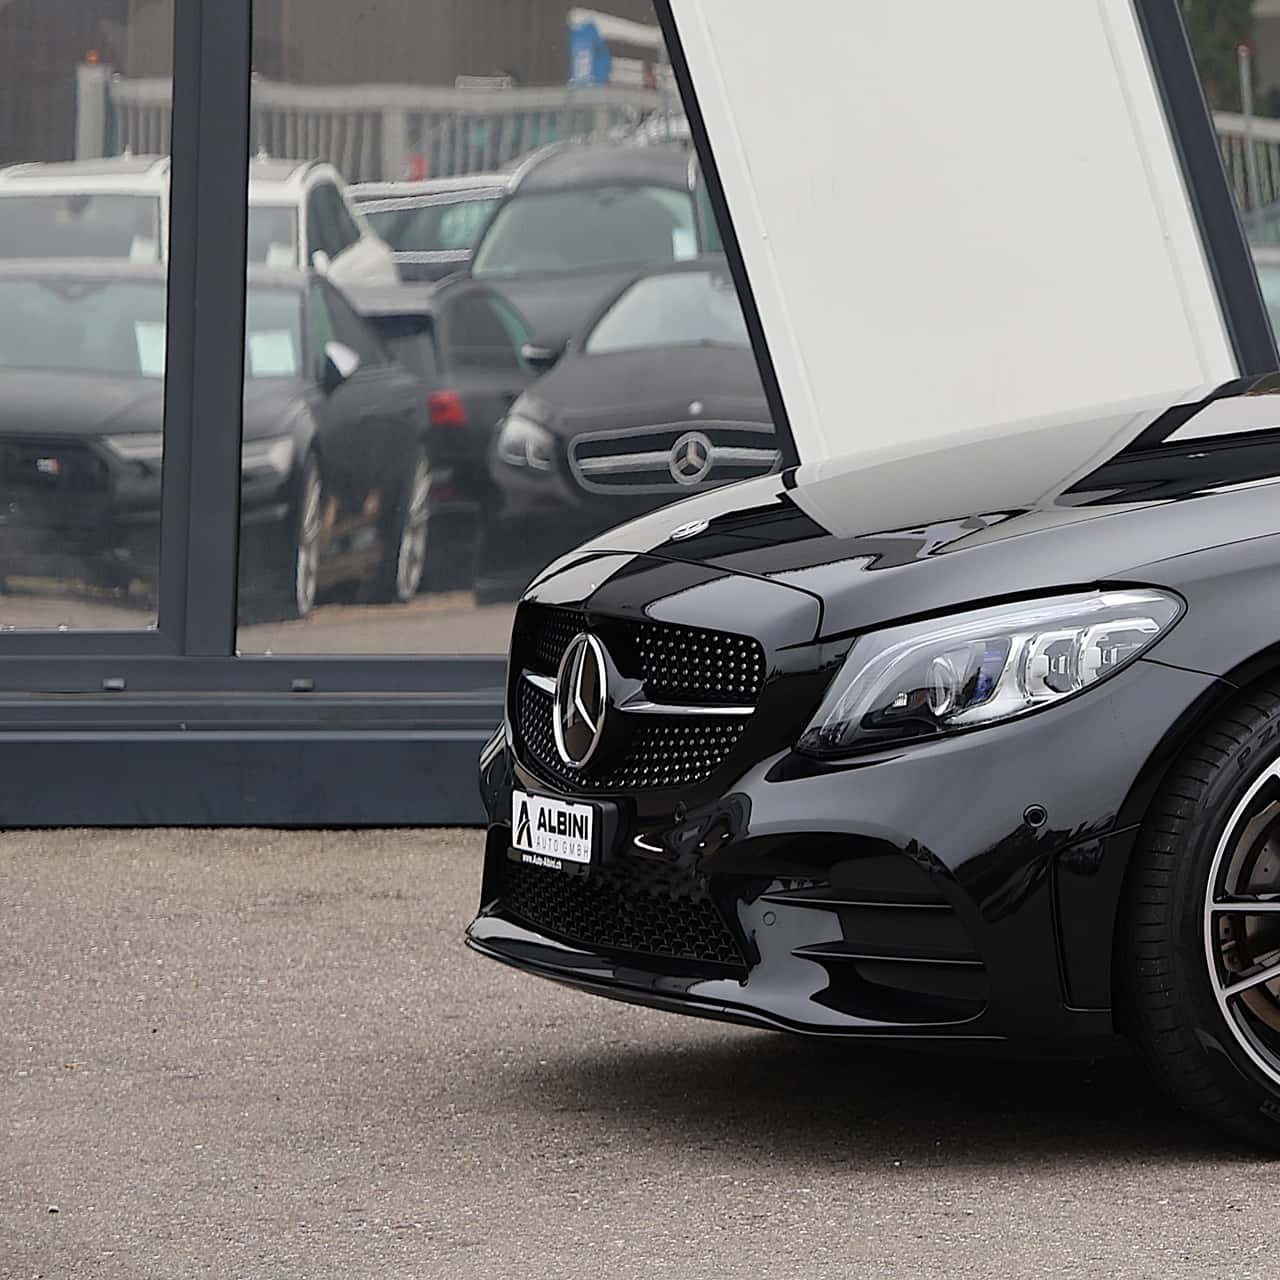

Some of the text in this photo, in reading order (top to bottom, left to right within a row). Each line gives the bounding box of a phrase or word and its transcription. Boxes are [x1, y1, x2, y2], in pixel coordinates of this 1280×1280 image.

[537, 806, 589, 841] ALBINI
[536, 835, 589, 859] AUTO GMBH
